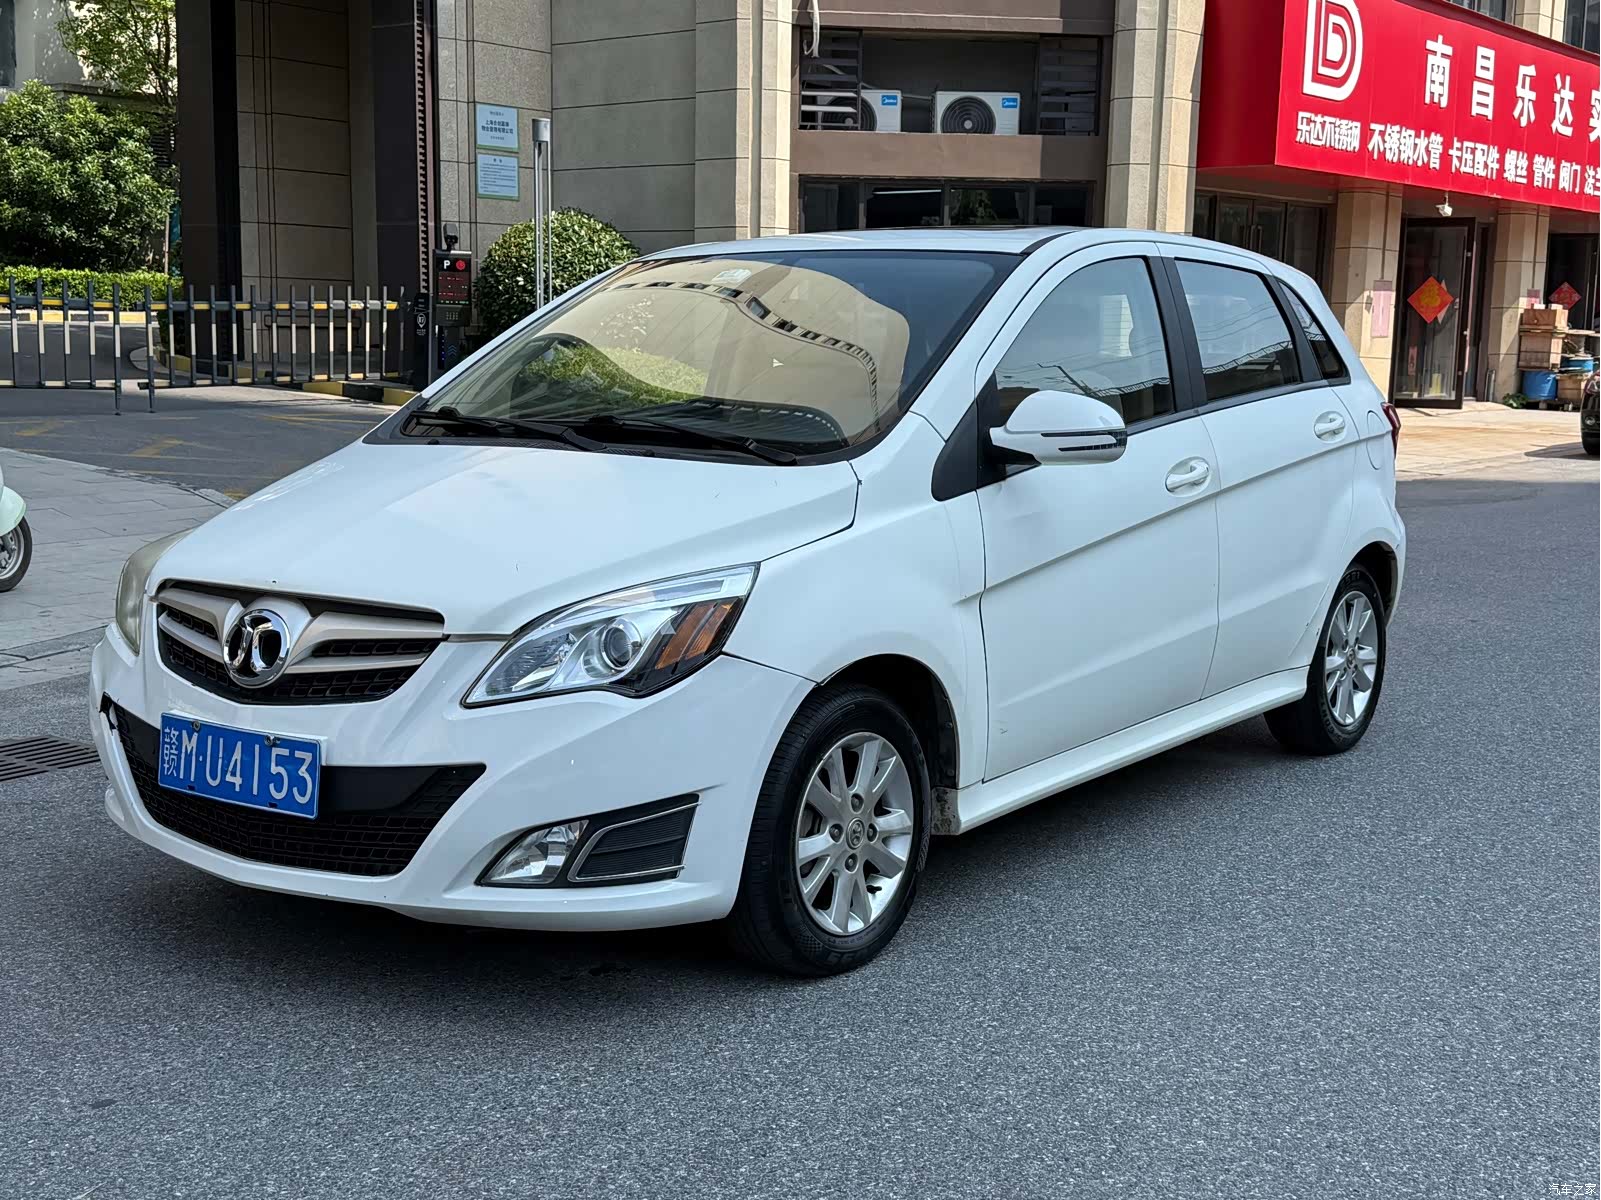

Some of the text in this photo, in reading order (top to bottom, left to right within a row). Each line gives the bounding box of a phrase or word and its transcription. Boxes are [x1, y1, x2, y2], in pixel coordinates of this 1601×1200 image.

[1295, 111, 1361, 152] 乐达不锈钢
[1367, 122, 1443, 170] 不锈钢水管
[1449, 137, 1499, 180] 卡压配件
[1504, 148, 1528, 184] 螺丝
[1533, 154, 1556, 188] 管件
[1559, 160, 1580, 193] 阀门
[443, 259, 451, 270] P
